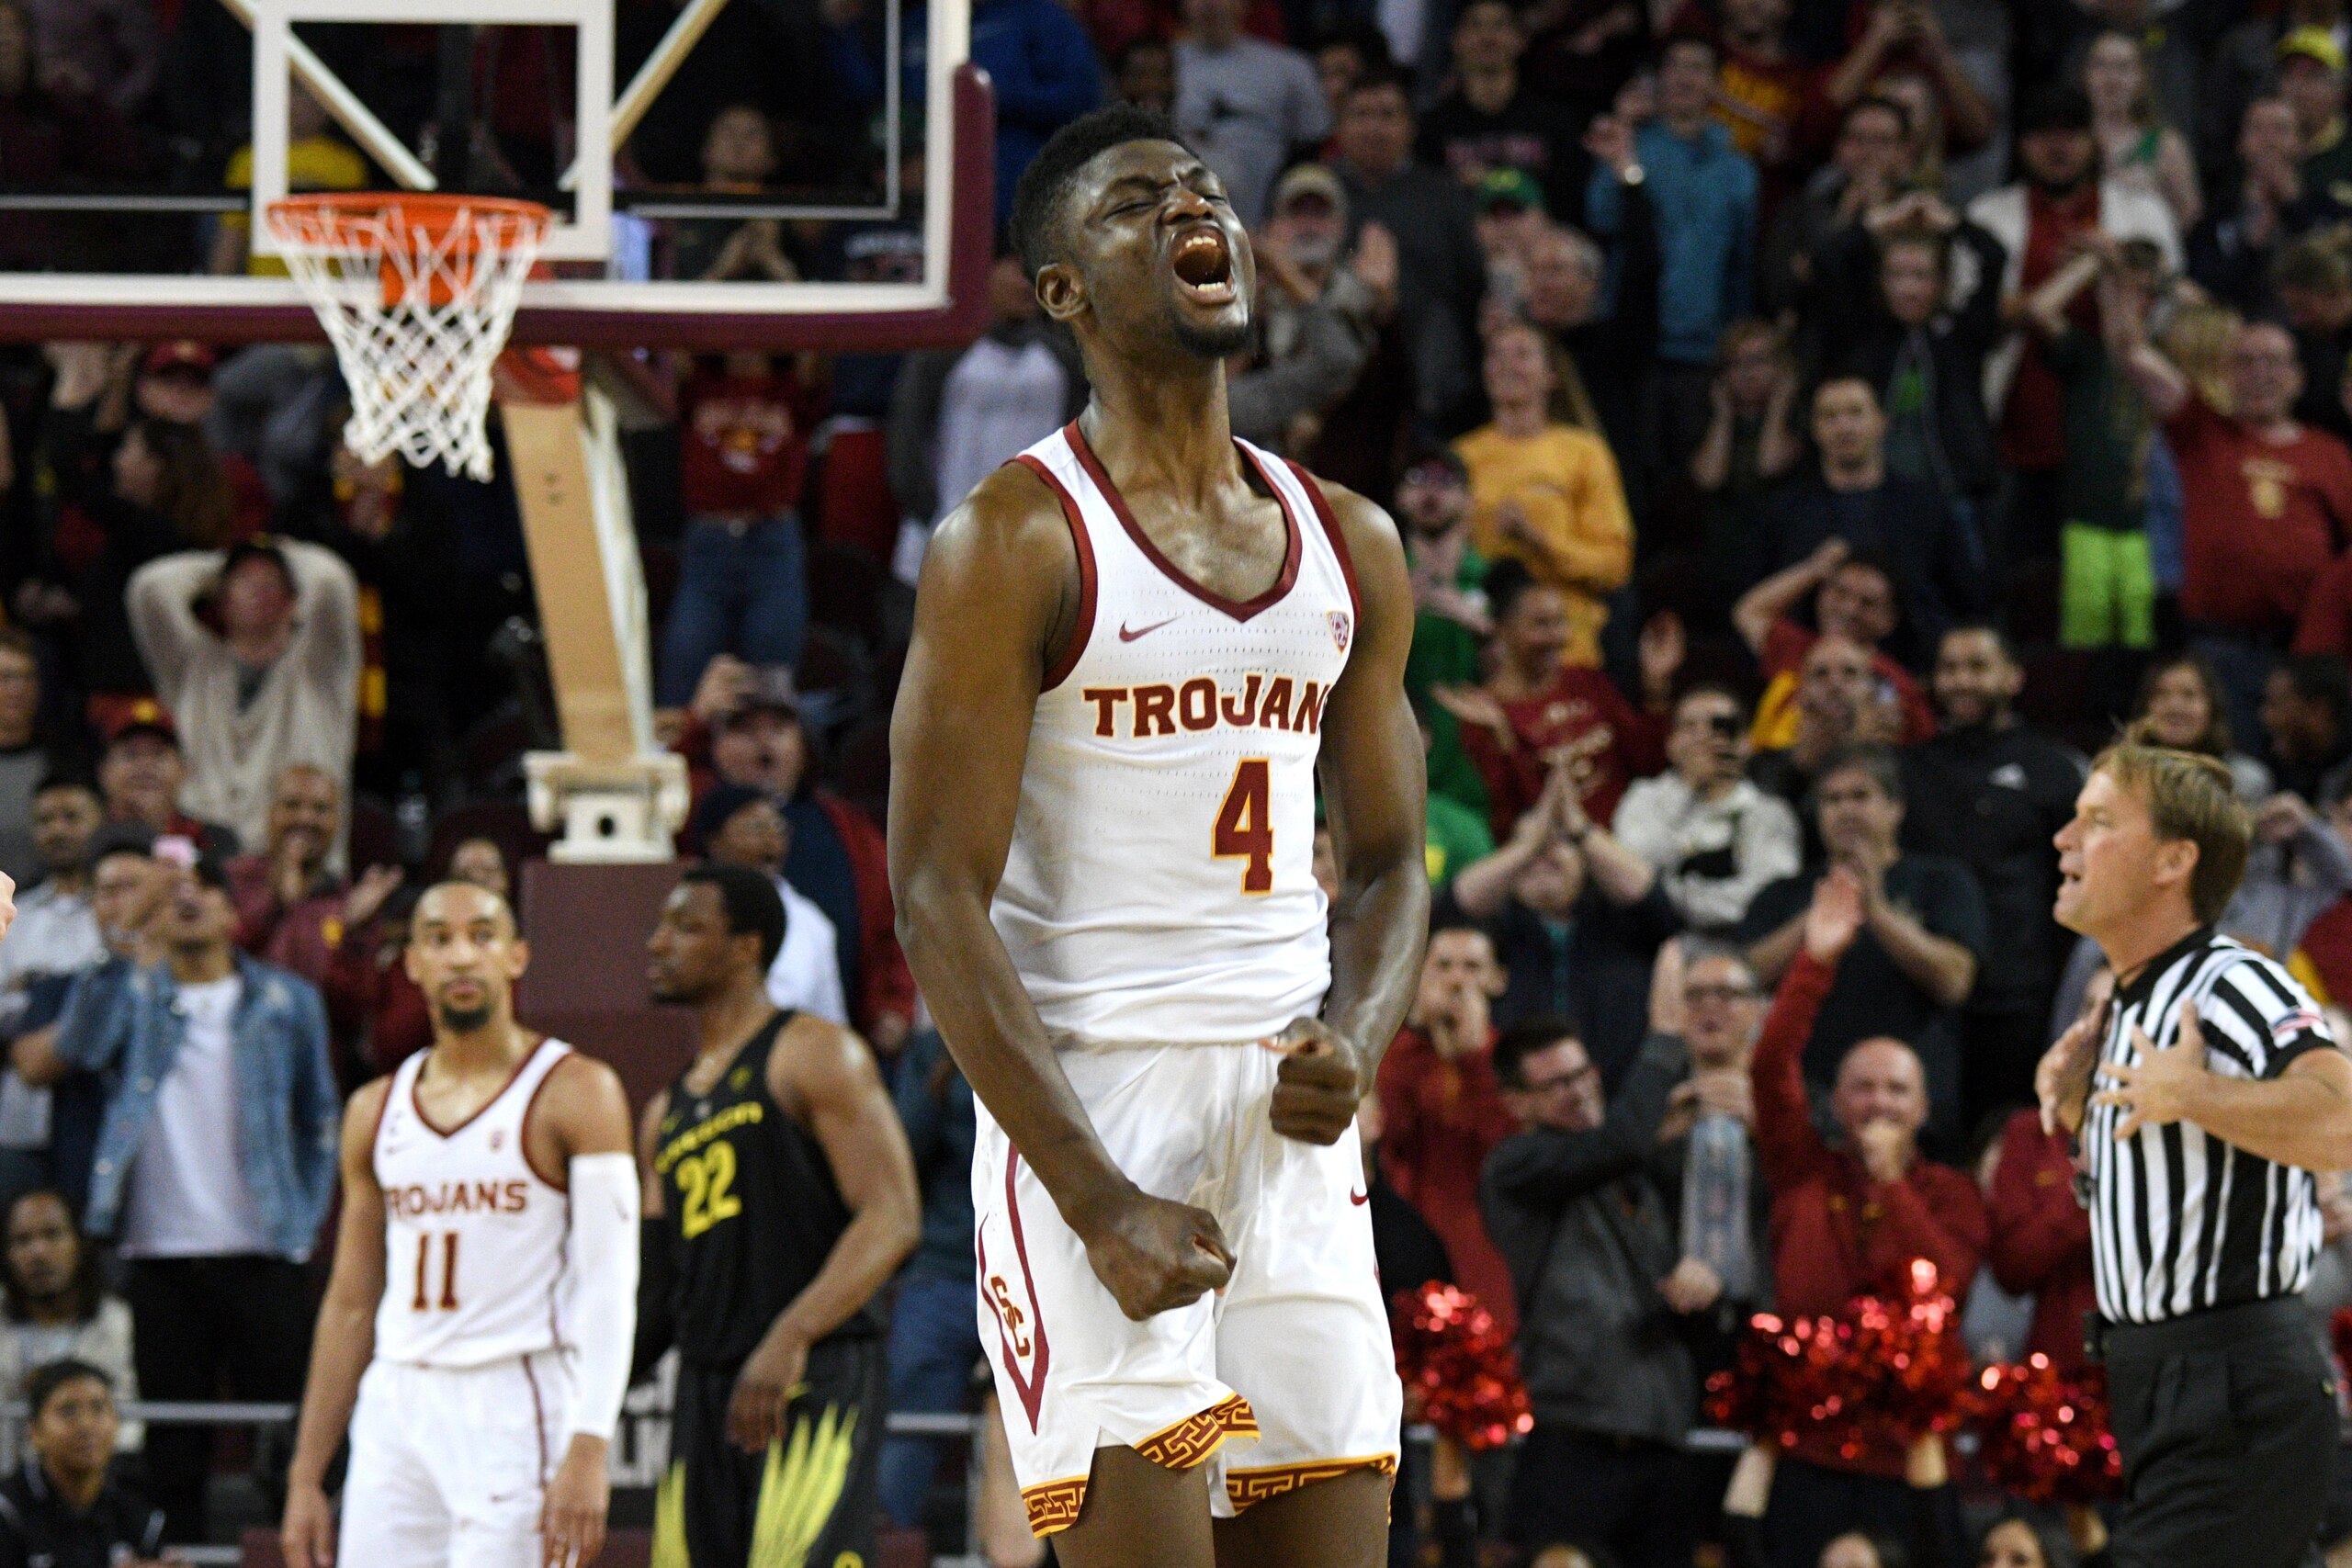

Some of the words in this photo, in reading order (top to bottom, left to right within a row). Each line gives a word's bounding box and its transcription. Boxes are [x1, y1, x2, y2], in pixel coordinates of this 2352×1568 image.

[1211, 757, 1273, 896] 4
[675, 1140, 742, 1240] 22
[412, 1230, 459, 1311] 11
